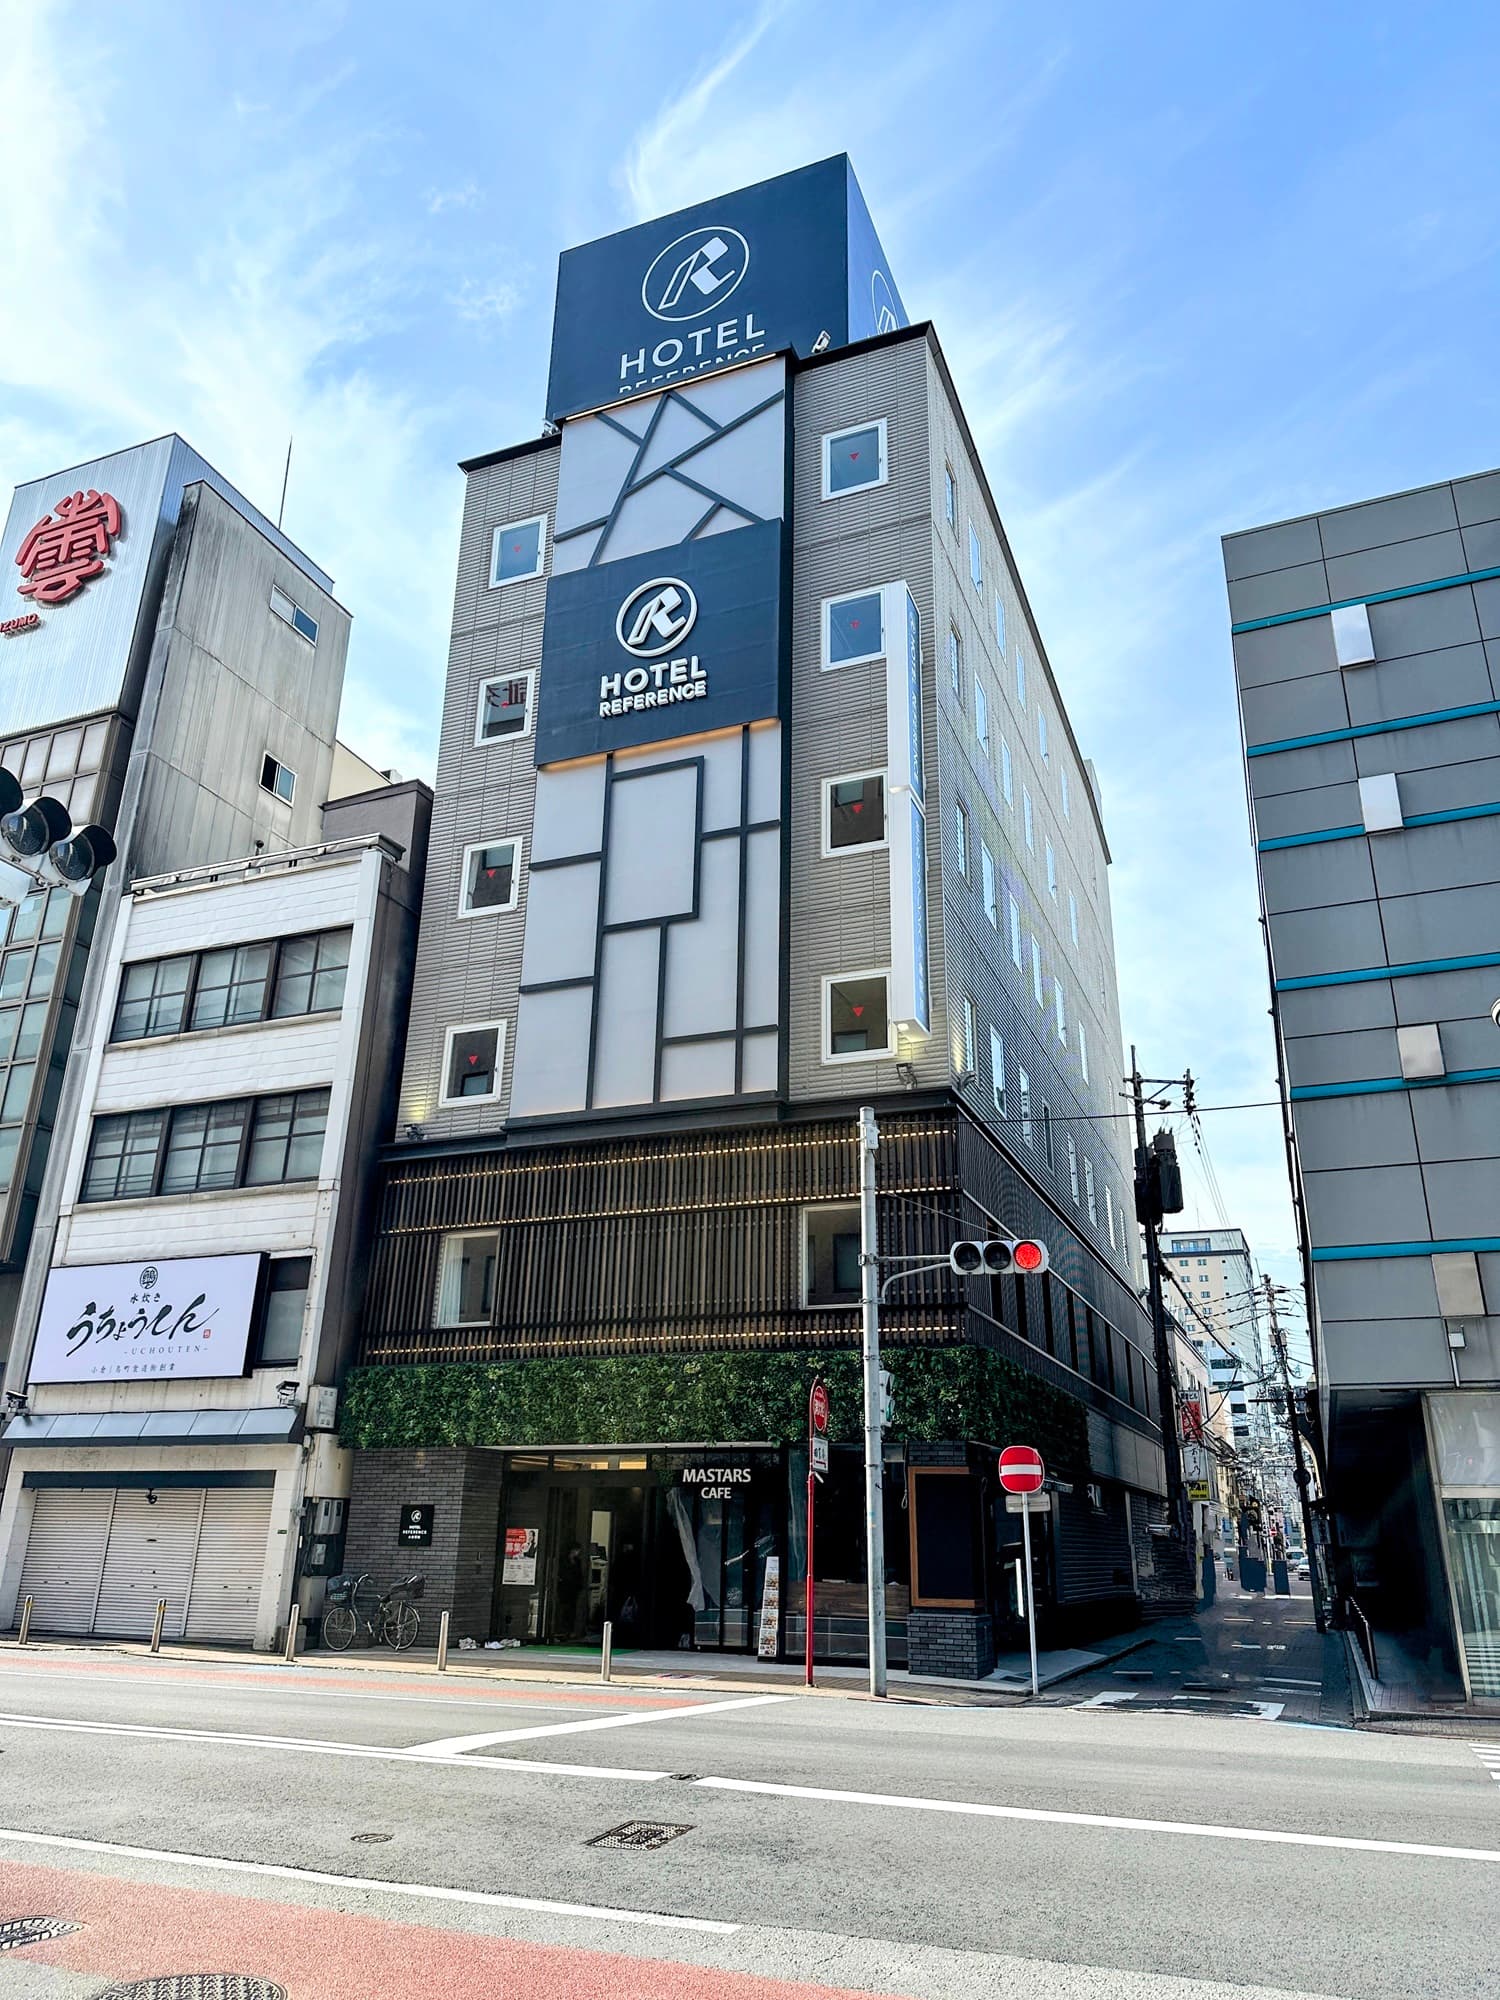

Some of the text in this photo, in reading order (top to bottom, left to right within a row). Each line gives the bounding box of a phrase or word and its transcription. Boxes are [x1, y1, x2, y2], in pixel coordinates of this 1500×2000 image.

[619, 313, 766, 380] HOTEL
[600, 655, 707, 699] HOTEL
[599, 680, 707, 718] REFERENCE
[130, 1292, 161, 1304] 水炊き
[682, 1468, 752, 1483] MASTARS
[701, 1487, 732, 1499] CAFE
